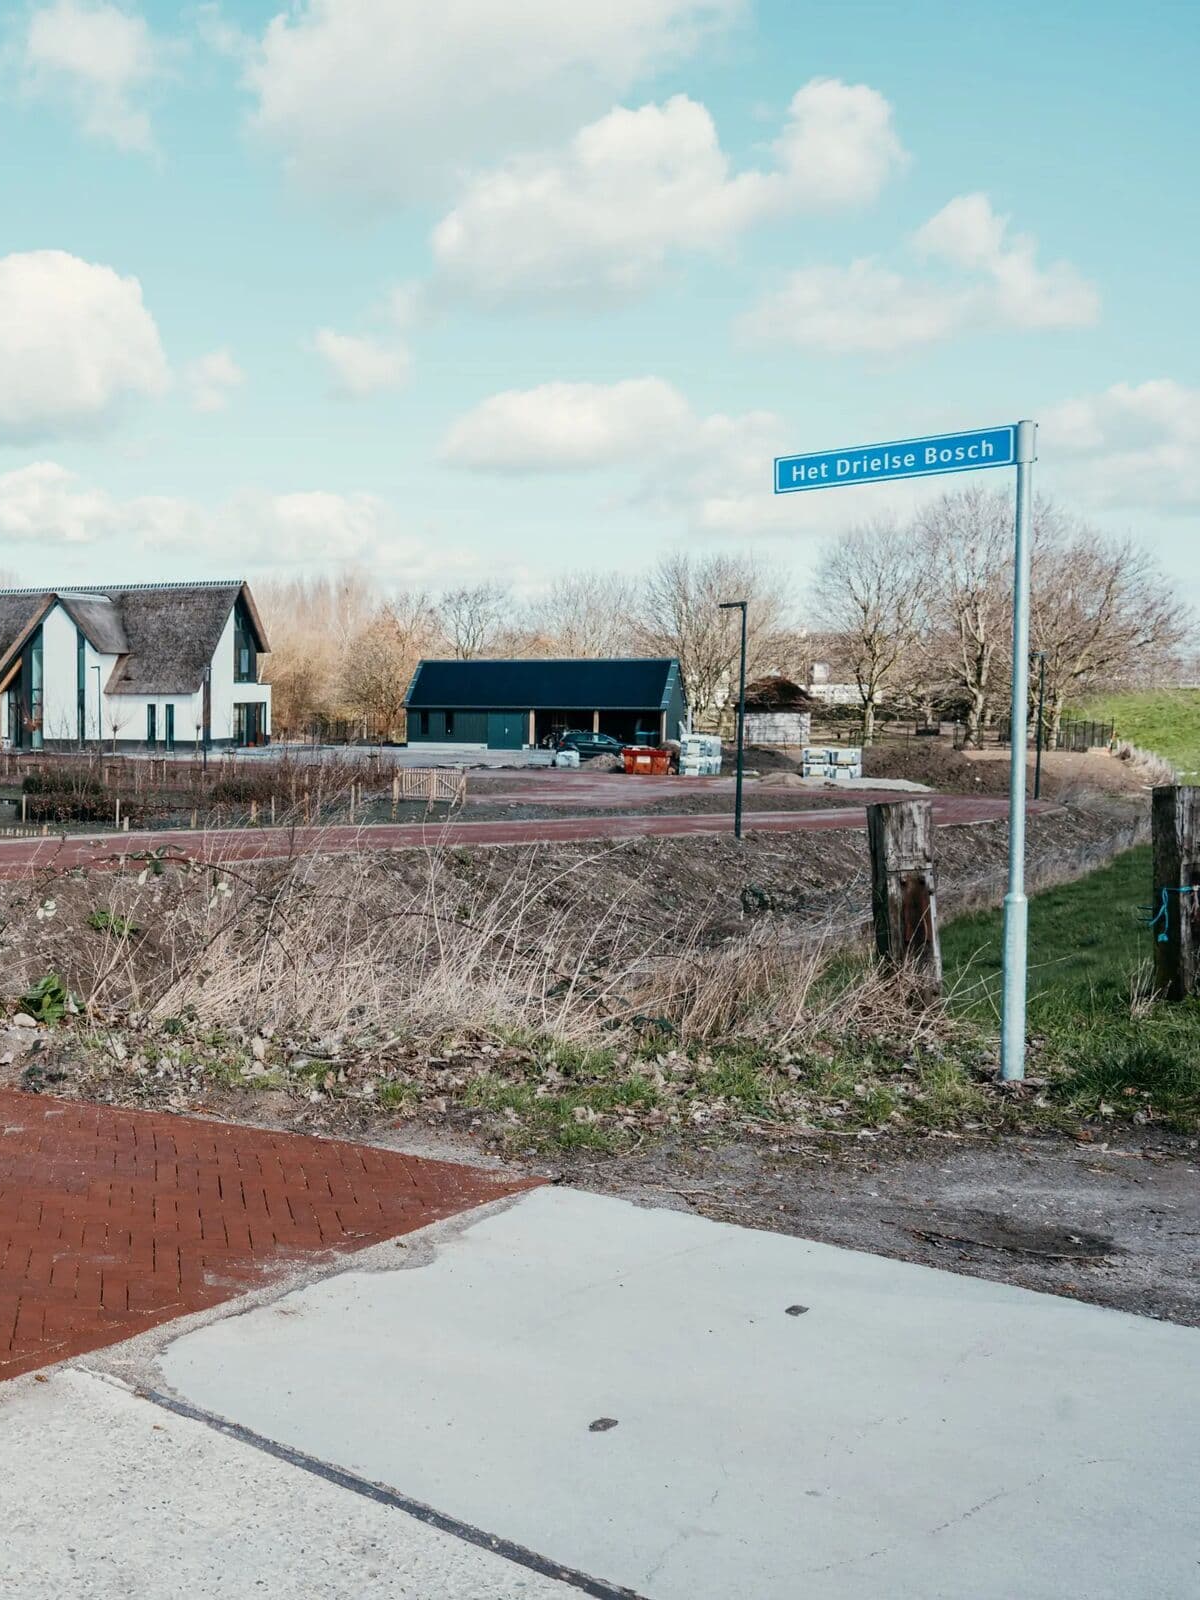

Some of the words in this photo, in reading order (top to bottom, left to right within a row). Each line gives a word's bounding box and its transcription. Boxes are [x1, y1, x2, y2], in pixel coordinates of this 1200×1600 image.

[792, 461, 828, 481] Het
[836, 452, 915, 476] Drielse
[924, 440, 994, 464] Bosch
